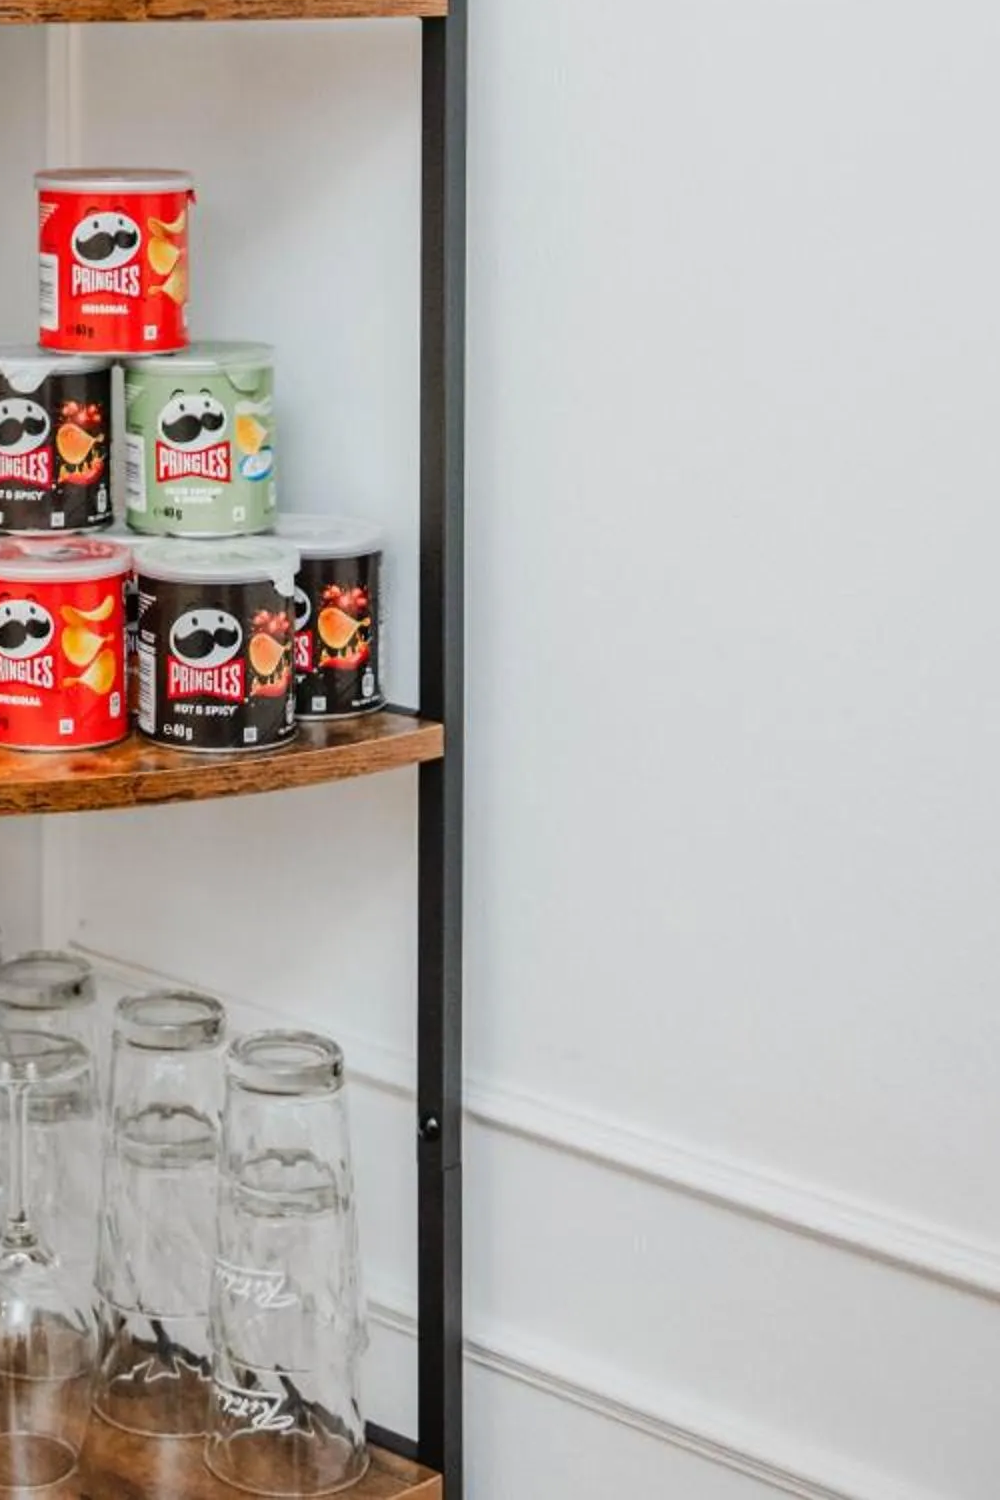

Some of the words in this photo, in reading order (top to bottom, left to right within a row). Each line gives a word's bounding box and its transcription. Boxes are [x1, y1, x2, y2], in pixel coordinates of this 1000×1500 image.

[71, 263, 141, 297] PRINGLES
[159, 444, 227, 478] PRINGLES
[13, 490, 43, 501] SPICY
[170, 661, 241, 697] PRINGLES
[173, 703, 194, 715] HOT
[204, 704, 236, 717] SPICY
